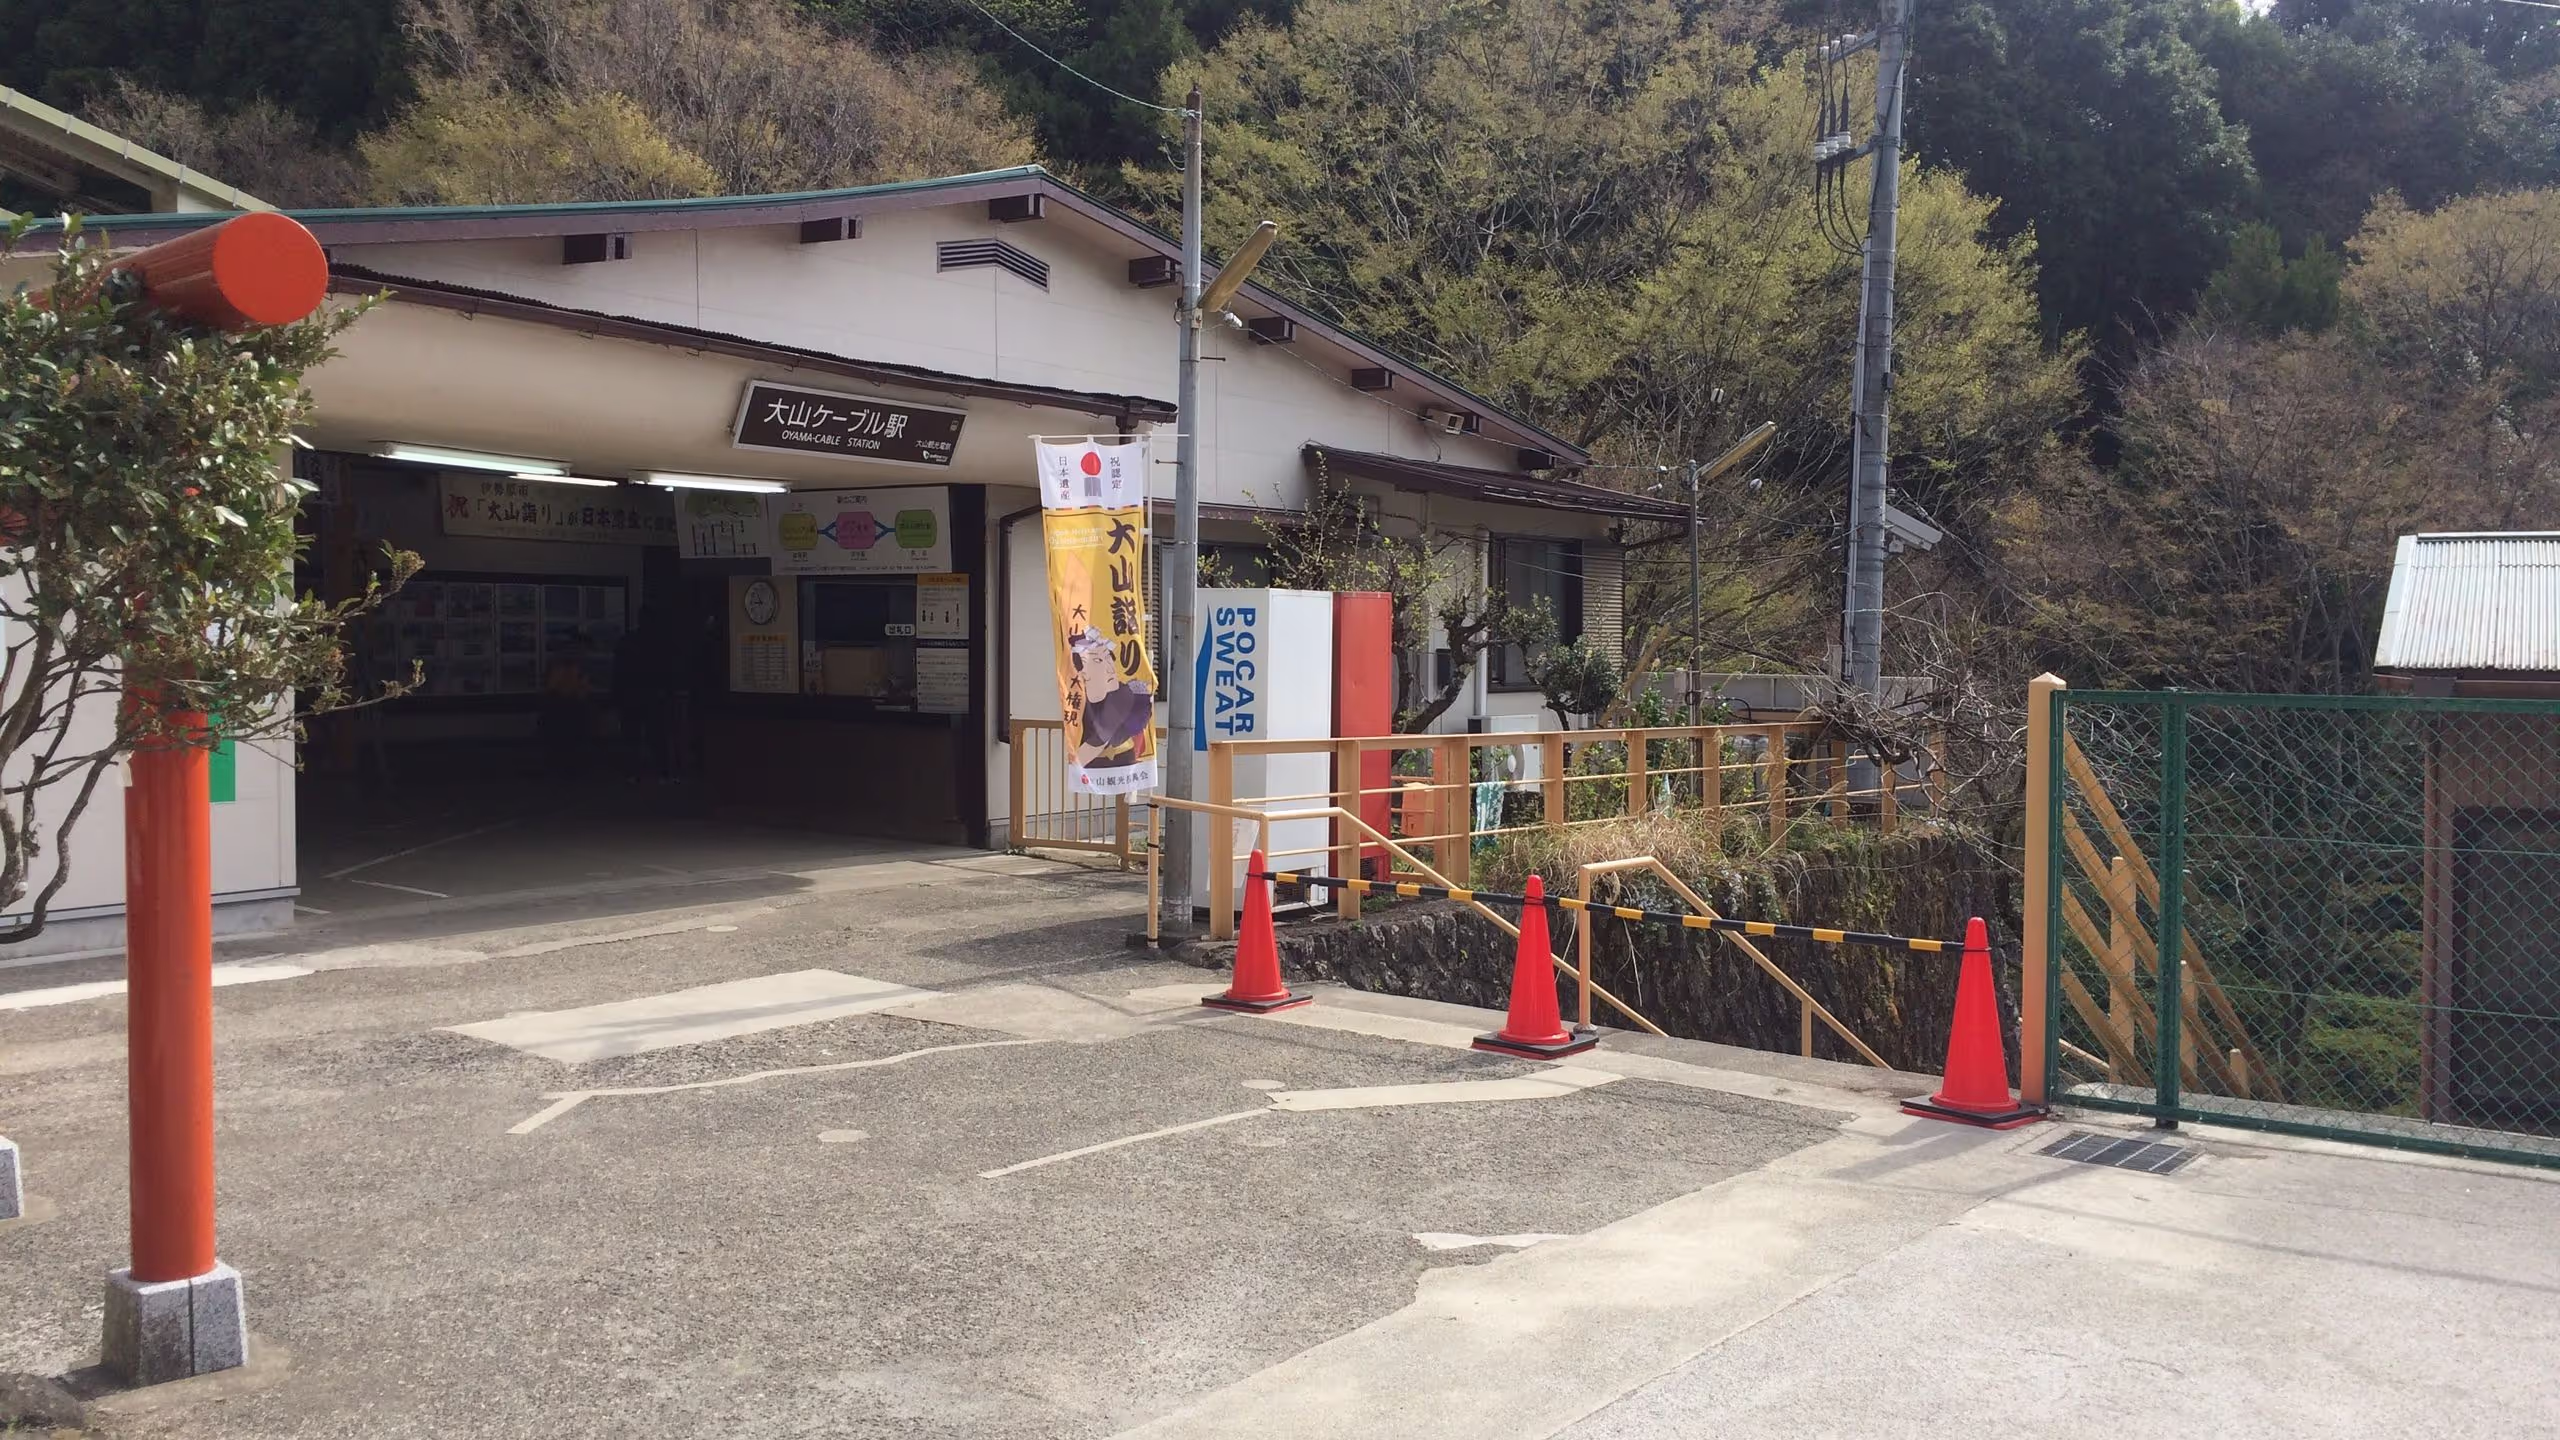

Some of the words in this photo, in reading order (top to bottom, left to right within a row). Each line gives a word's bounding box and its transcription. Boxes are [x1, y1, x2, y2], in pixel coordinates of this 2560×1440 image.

[763, 398, 909, 439] 大山ケーブル駅
[781, 430, 841, 447] OYAMA-CABLE
[847, 437, 881, 450] STATION
[1059, 456, 1071, 501] 日本遺産
[1110, 456, 1122, 490] 祝認定
[1106, 517, 1142, 677] 大山詣り
[888, 625, 912, 635] 出札口
[1216, 607, 1236, 736] SWEAT
